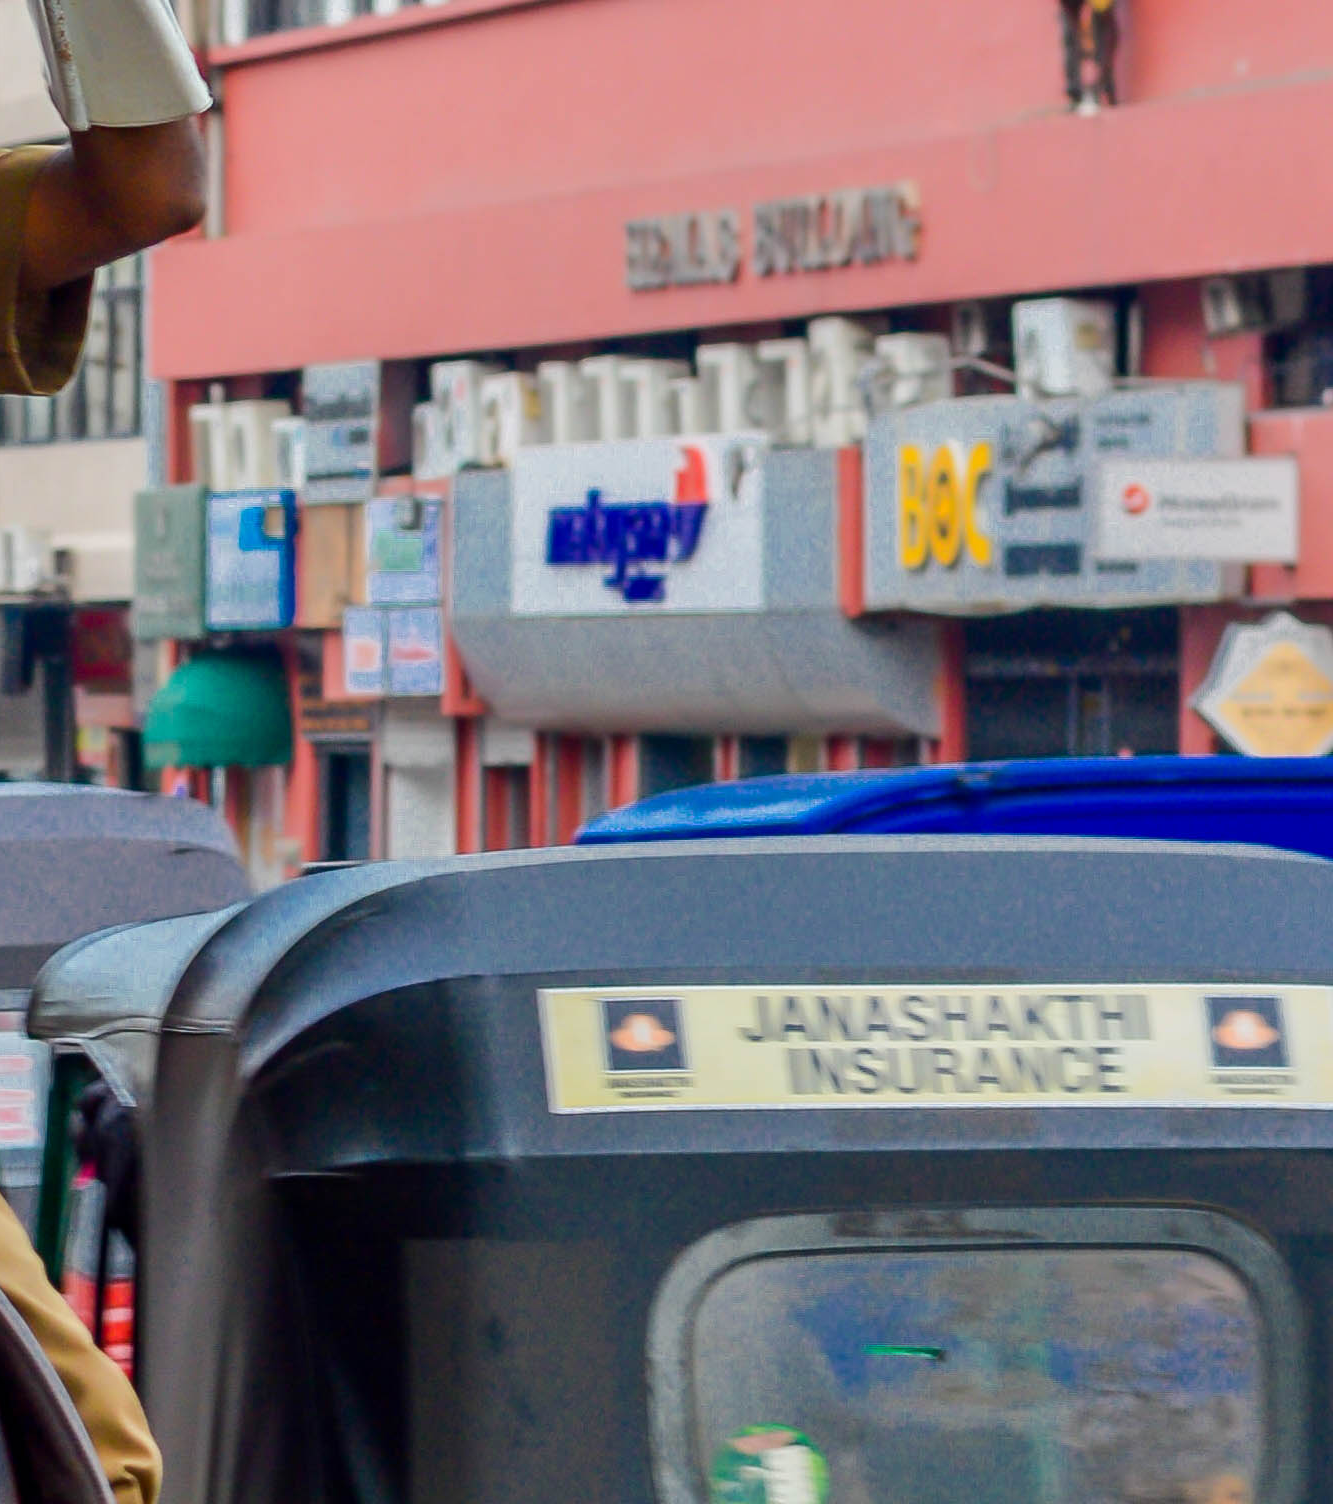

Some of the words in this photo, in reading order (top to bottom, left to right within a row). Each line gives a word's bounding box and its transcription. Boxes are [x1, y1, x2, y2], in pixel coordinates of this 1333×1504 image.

[898, 441, 992, 570] BOC
[737, 995, 1152, 1042] JANASHAKTHI
[785, 1047, 1130, 1094] INSURANCE
